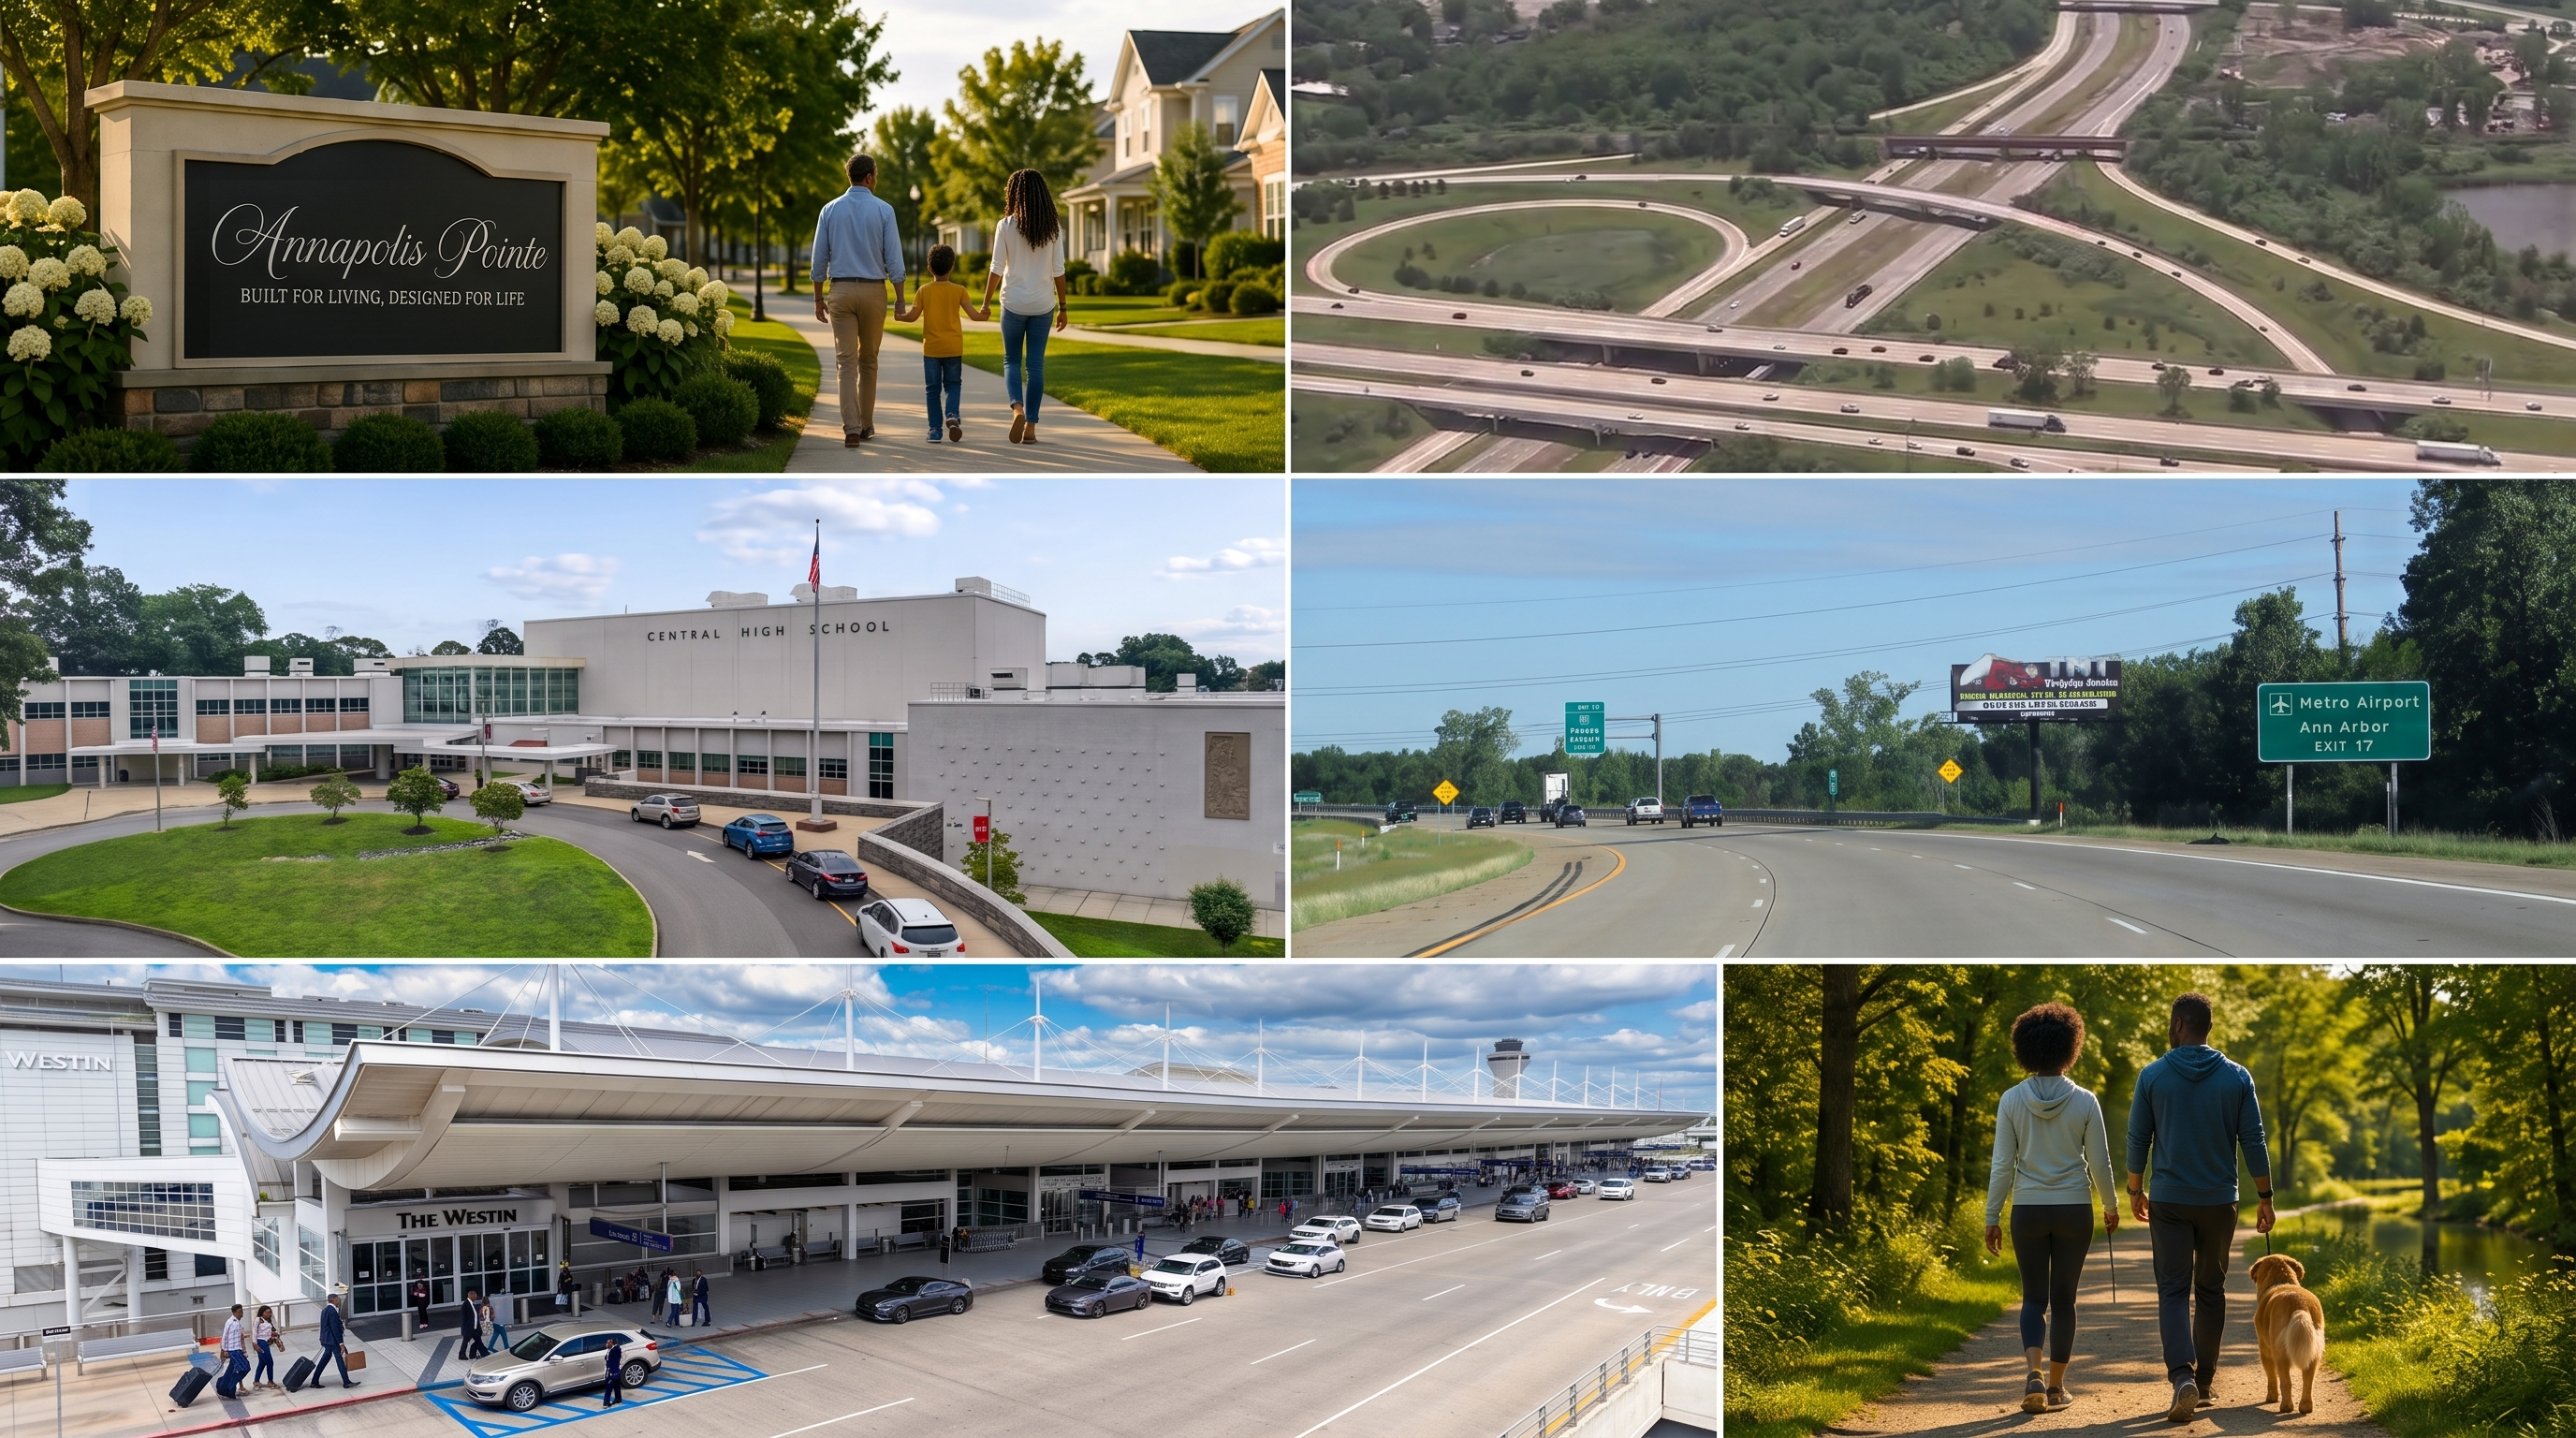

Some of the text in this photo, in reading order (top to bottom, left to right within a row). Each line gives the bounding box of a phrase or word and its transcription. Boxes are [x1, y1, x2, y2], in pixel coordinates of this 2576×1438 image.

[212, 203, 549, 280] Annapolis Pointe
[240, 288, 525, 307] BUILT FOR LIVING, DESIGNED FOR LIFE
[647, 621, 890, 642] CENTRAL HIGH SCHOOL
[2300, 695, 2420, 711] Metro Airport
[2300, 721, 2389, 734] Ann Arbor
[2315, 739, 2373, 752] EXIT 17
[5, 1050, 112, 1072] WESTIN
[396, 1209, 517, 1229] THE WESTIN
